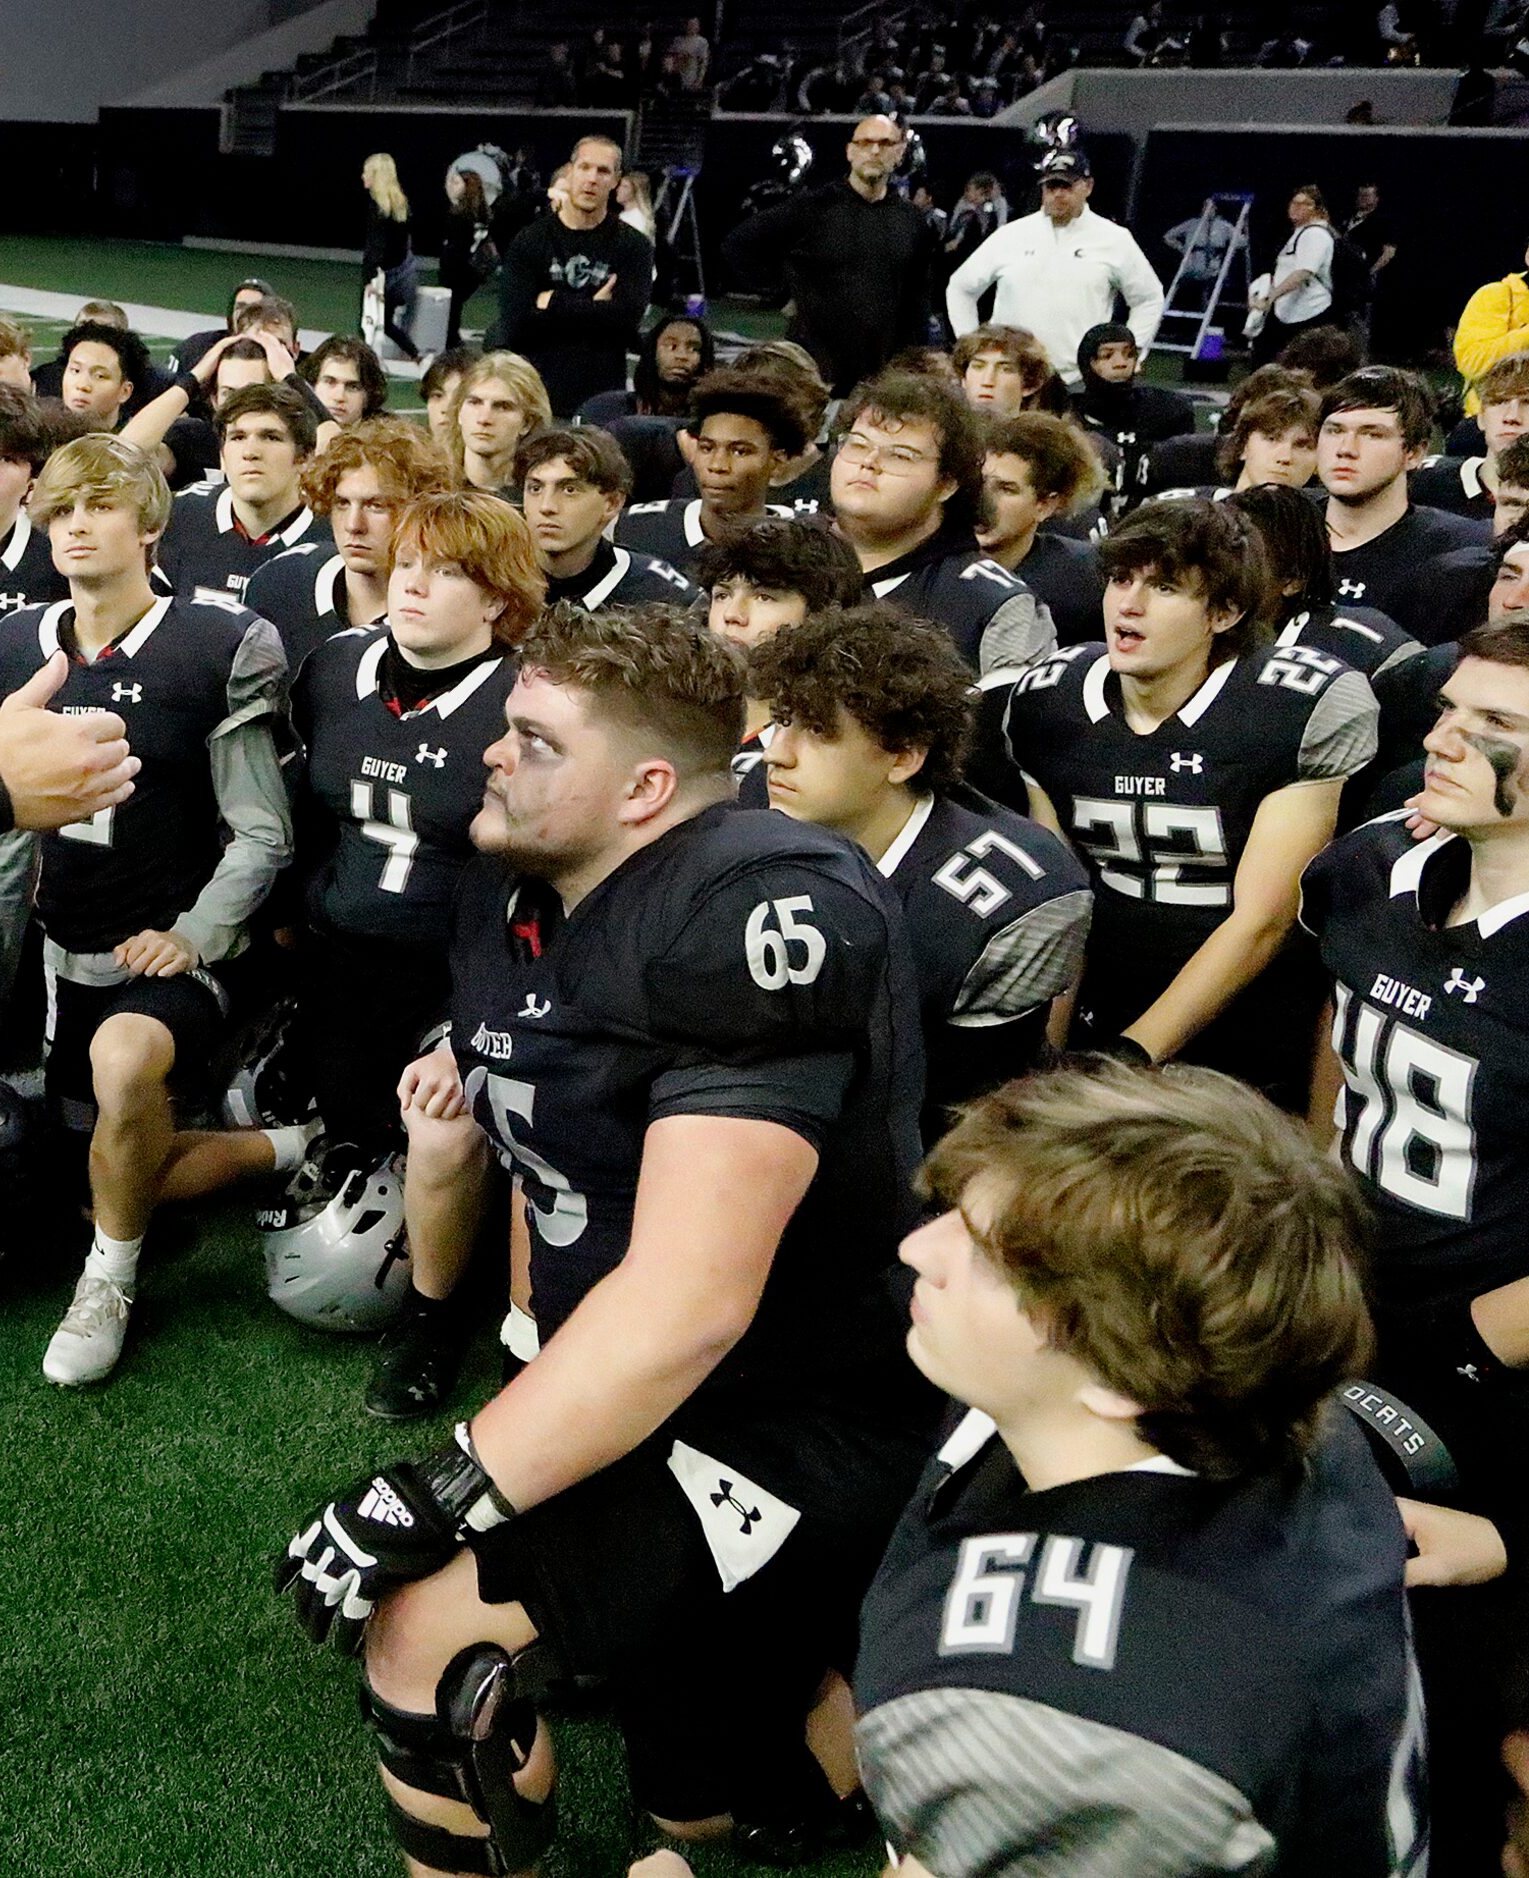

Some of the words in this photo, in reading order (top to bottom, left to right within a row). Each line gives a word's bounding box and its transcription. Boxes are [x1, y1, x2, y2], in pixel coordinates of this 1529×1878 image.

[1256, 645, 1344, 697] 22
[360, 755, 408, 785] GUYER
[1114, 775, 1167, 797] GUYER
[350, 778, 422, 895] 4
[930, 828, 1049, 920] 57
[1072, 795, 1230, 907] 22
[744, 894, 827, 991] 65
[1369, 972, 1433, 1021] GUYER
[1331, 978, 1481, 1225] 48
[937, 1531, 1136, 1670] 64
